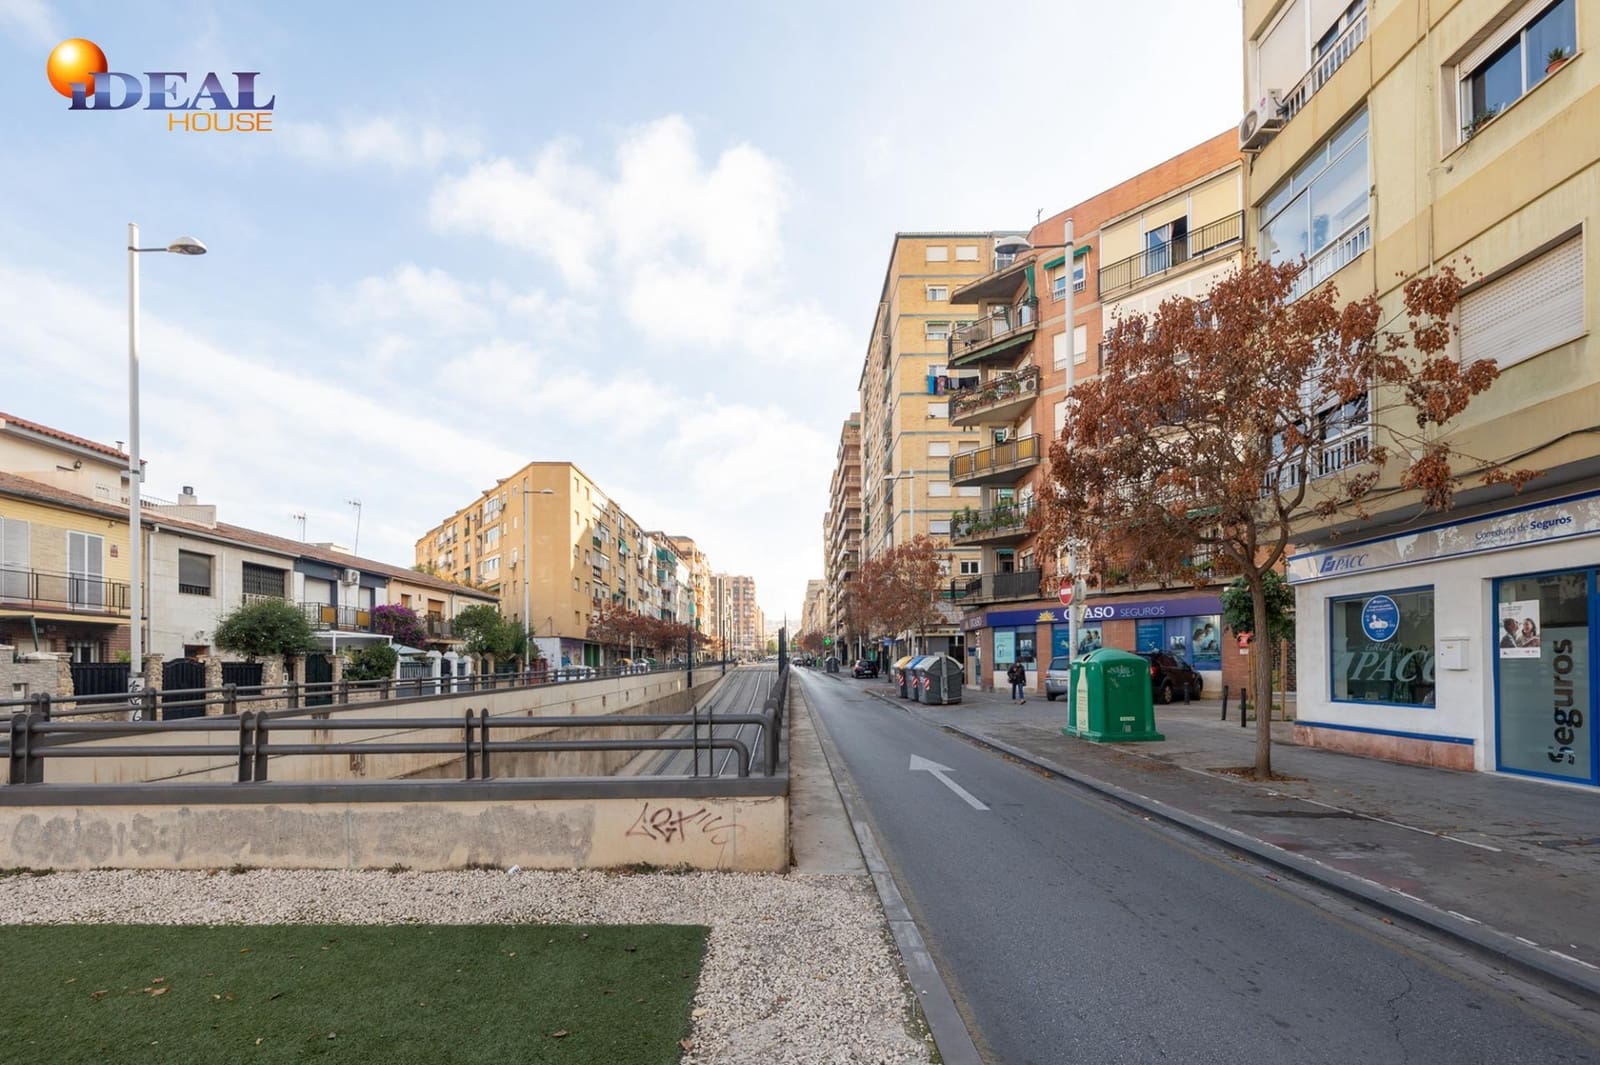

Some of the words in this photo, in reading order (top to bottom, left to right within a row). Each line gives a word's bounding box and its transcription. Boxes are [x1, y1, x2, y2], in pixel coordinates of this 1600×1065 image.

[1530, 516, 1572, 530] Seguros
[1120, 606, 1166, 617] SEGUROS
[1365, 643, 1402, 651] GRUPO
[1548, 638, 1583, 765] Seguros
